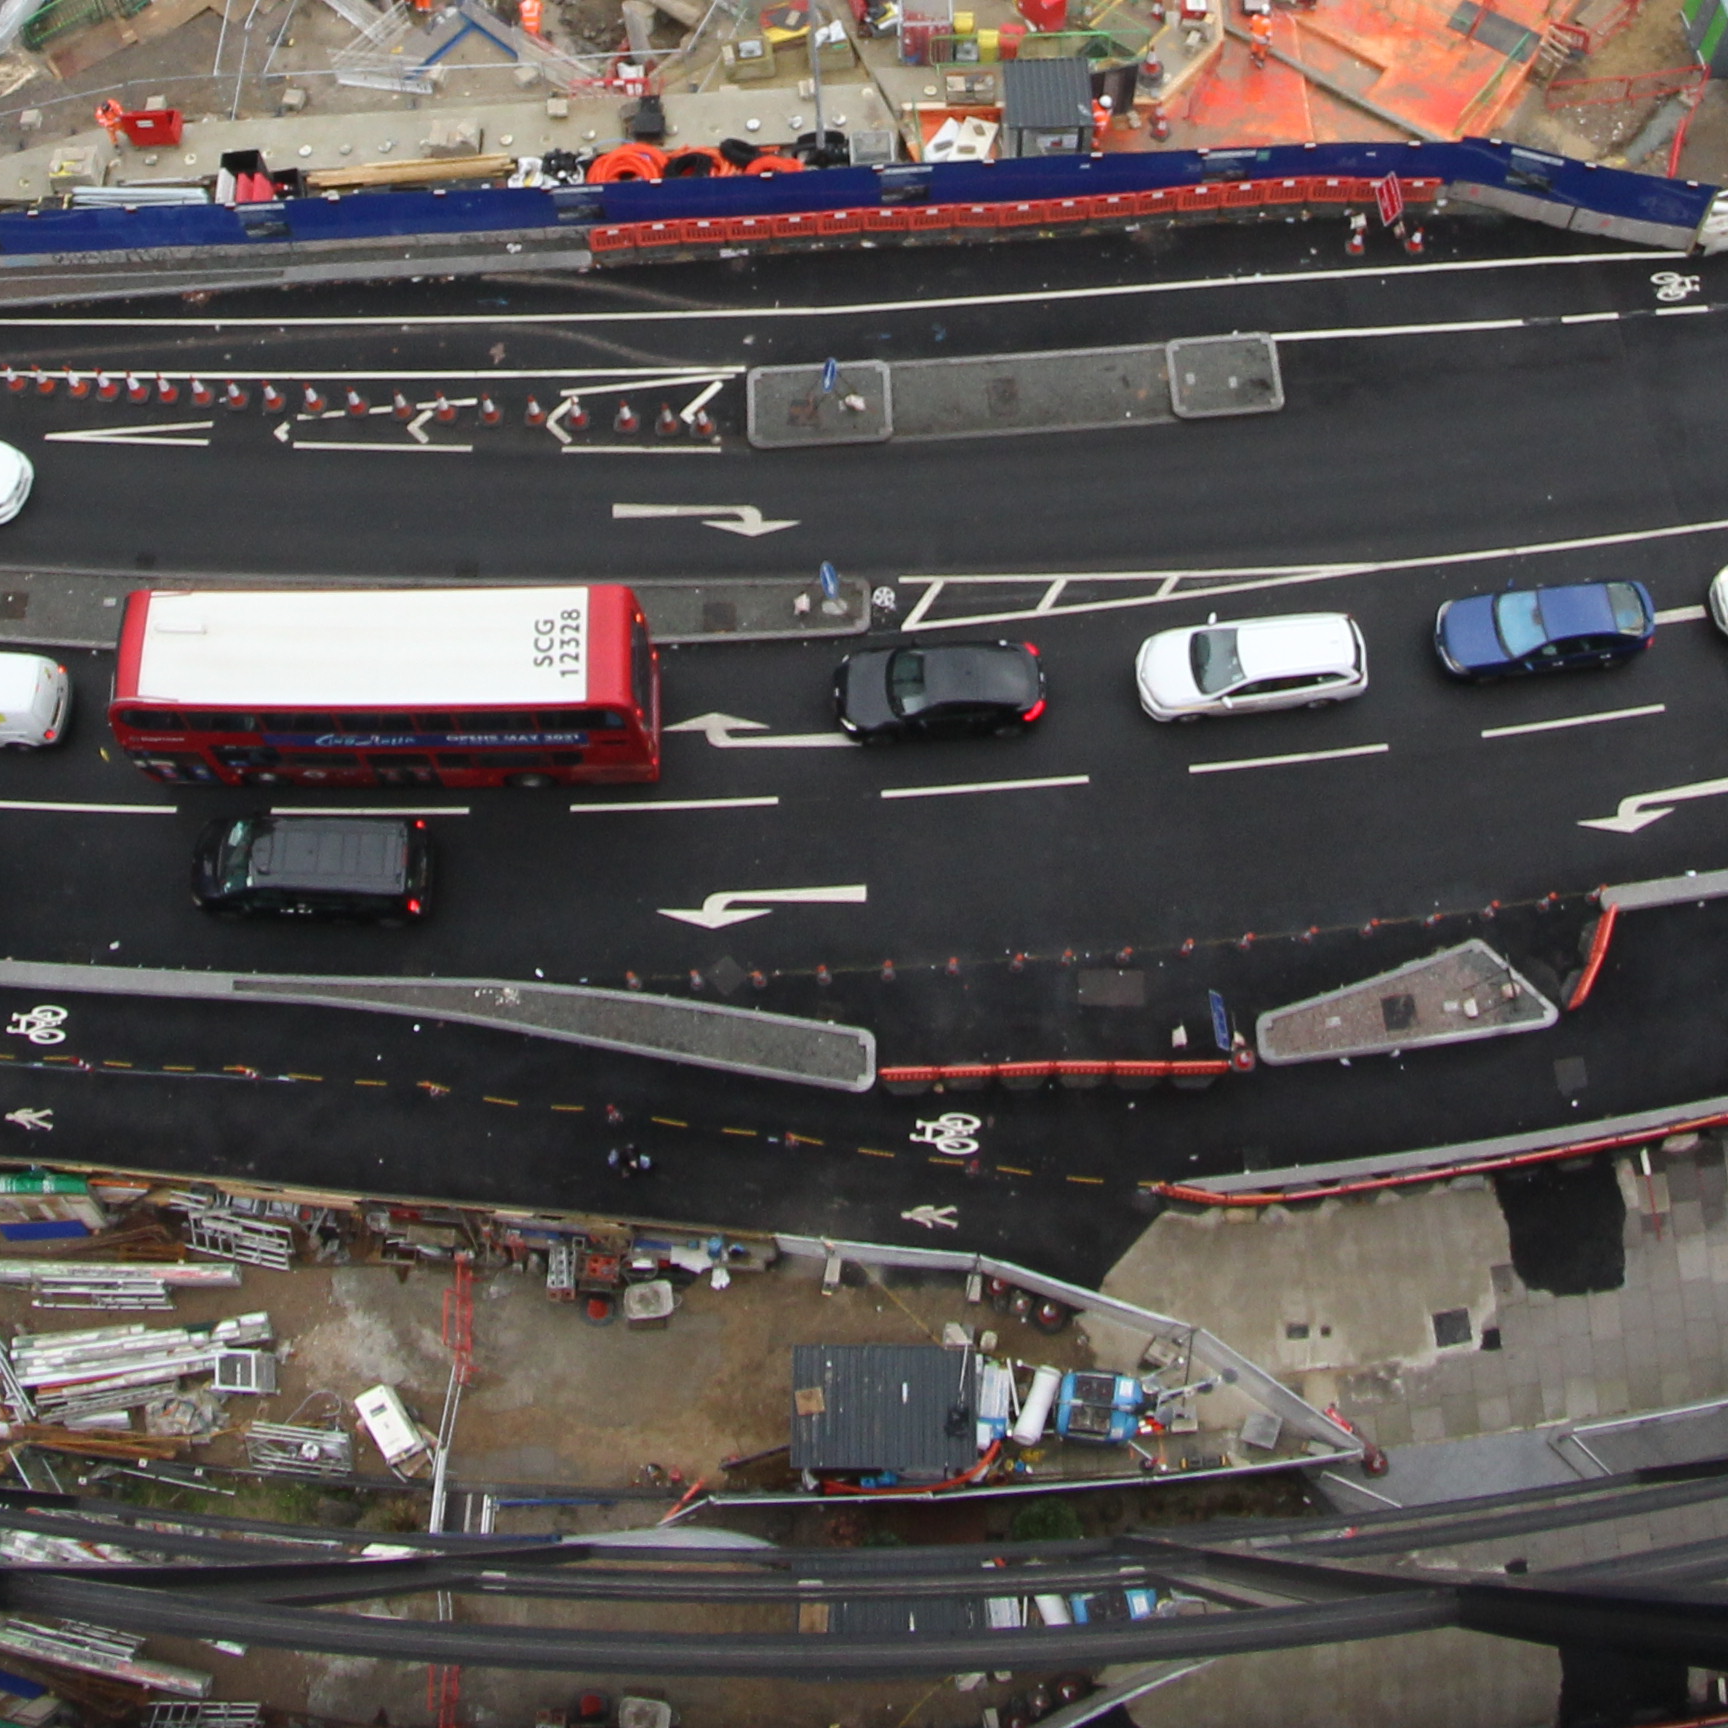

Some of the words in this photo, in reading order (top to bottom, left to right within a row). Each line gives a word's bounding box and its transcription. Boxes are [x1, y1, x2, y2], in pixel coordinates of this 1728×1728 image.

[534, 618, 555, 668] SCG
[560, 608, 581, 678] 12328
[446, 734, 499, 743] OPENS
[504, 734, 539, 744] MAY
[543, 734, 581, 744] 2021
